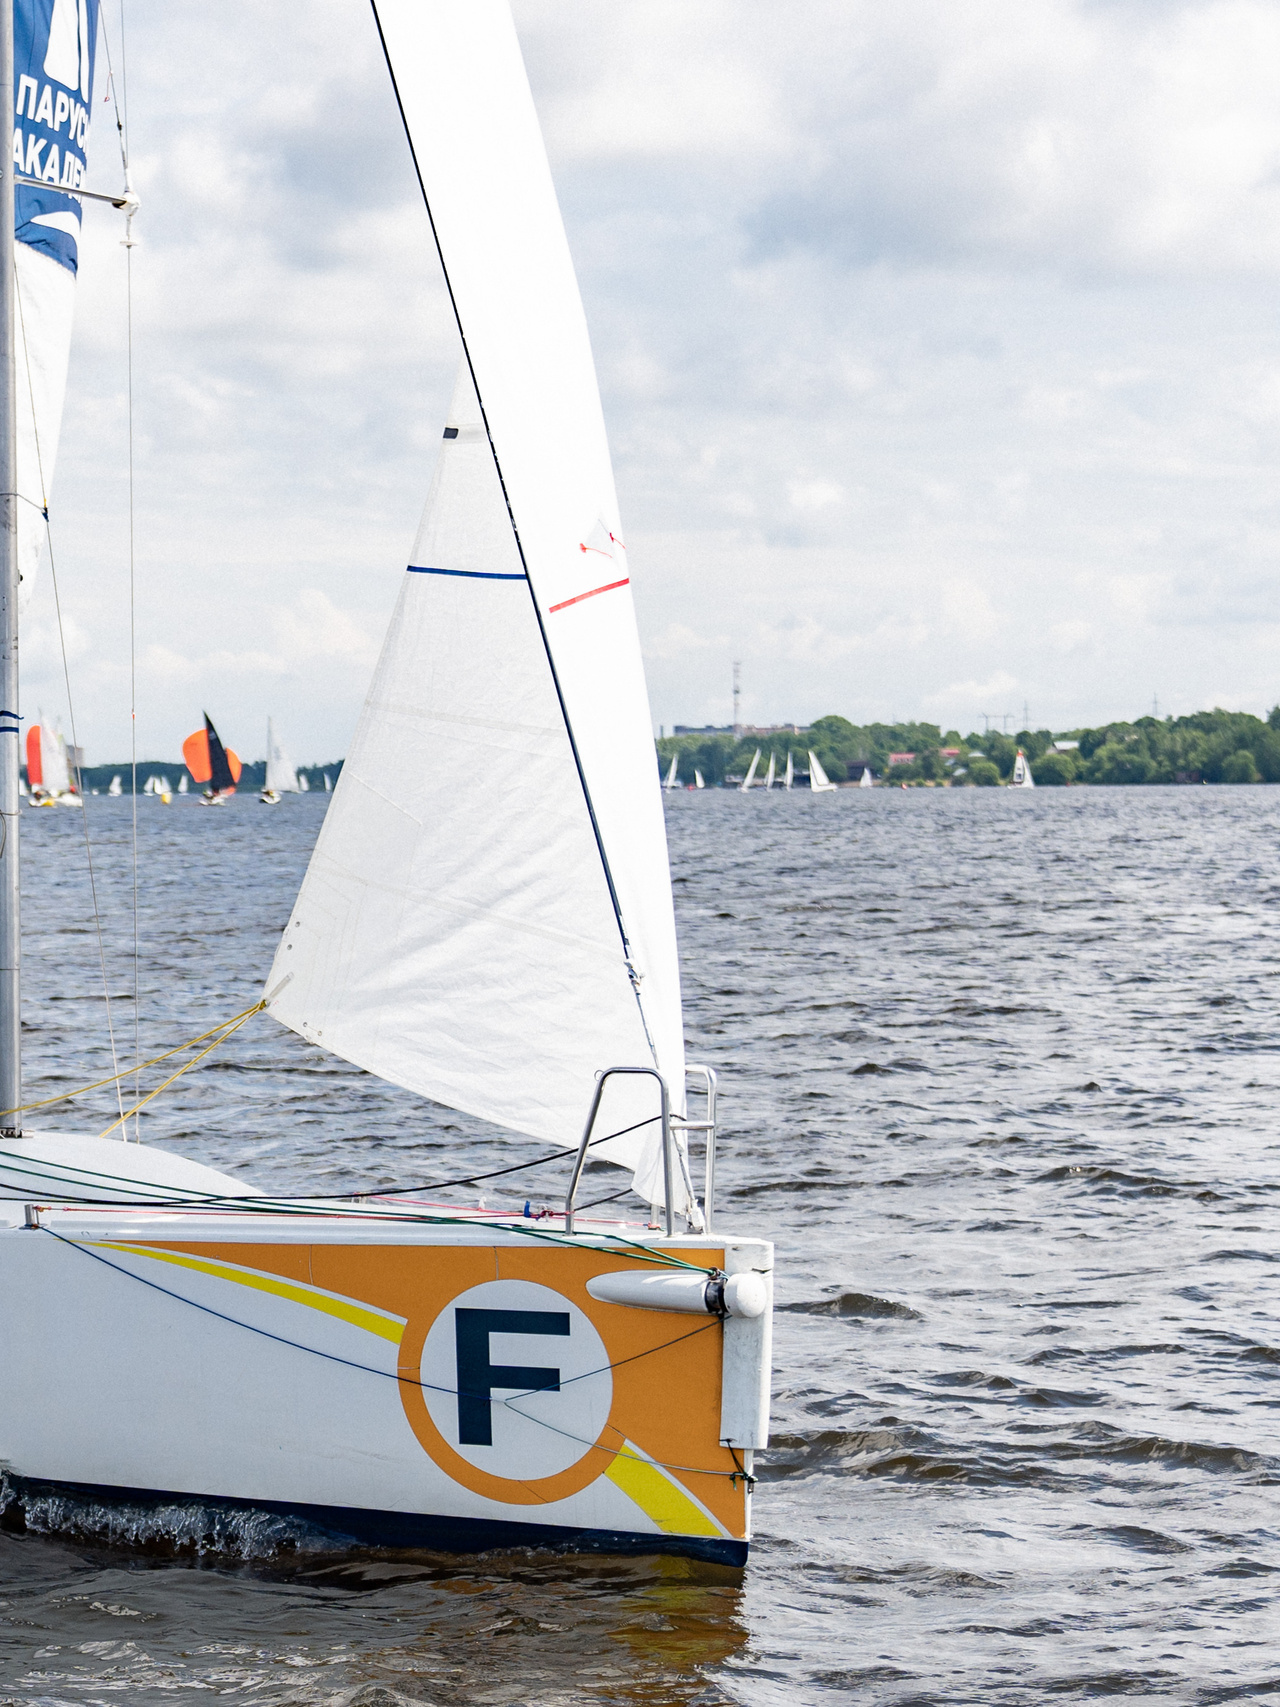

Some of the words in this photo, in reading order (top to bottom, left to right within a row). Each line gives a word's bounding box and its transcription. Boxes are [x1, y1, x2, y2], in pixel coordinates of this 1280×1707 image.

[16, 73, 91, 155] ПАРУС
[13, 127, 88, 204] АКАДЕ
[455, 1307, 570, 1446] F
